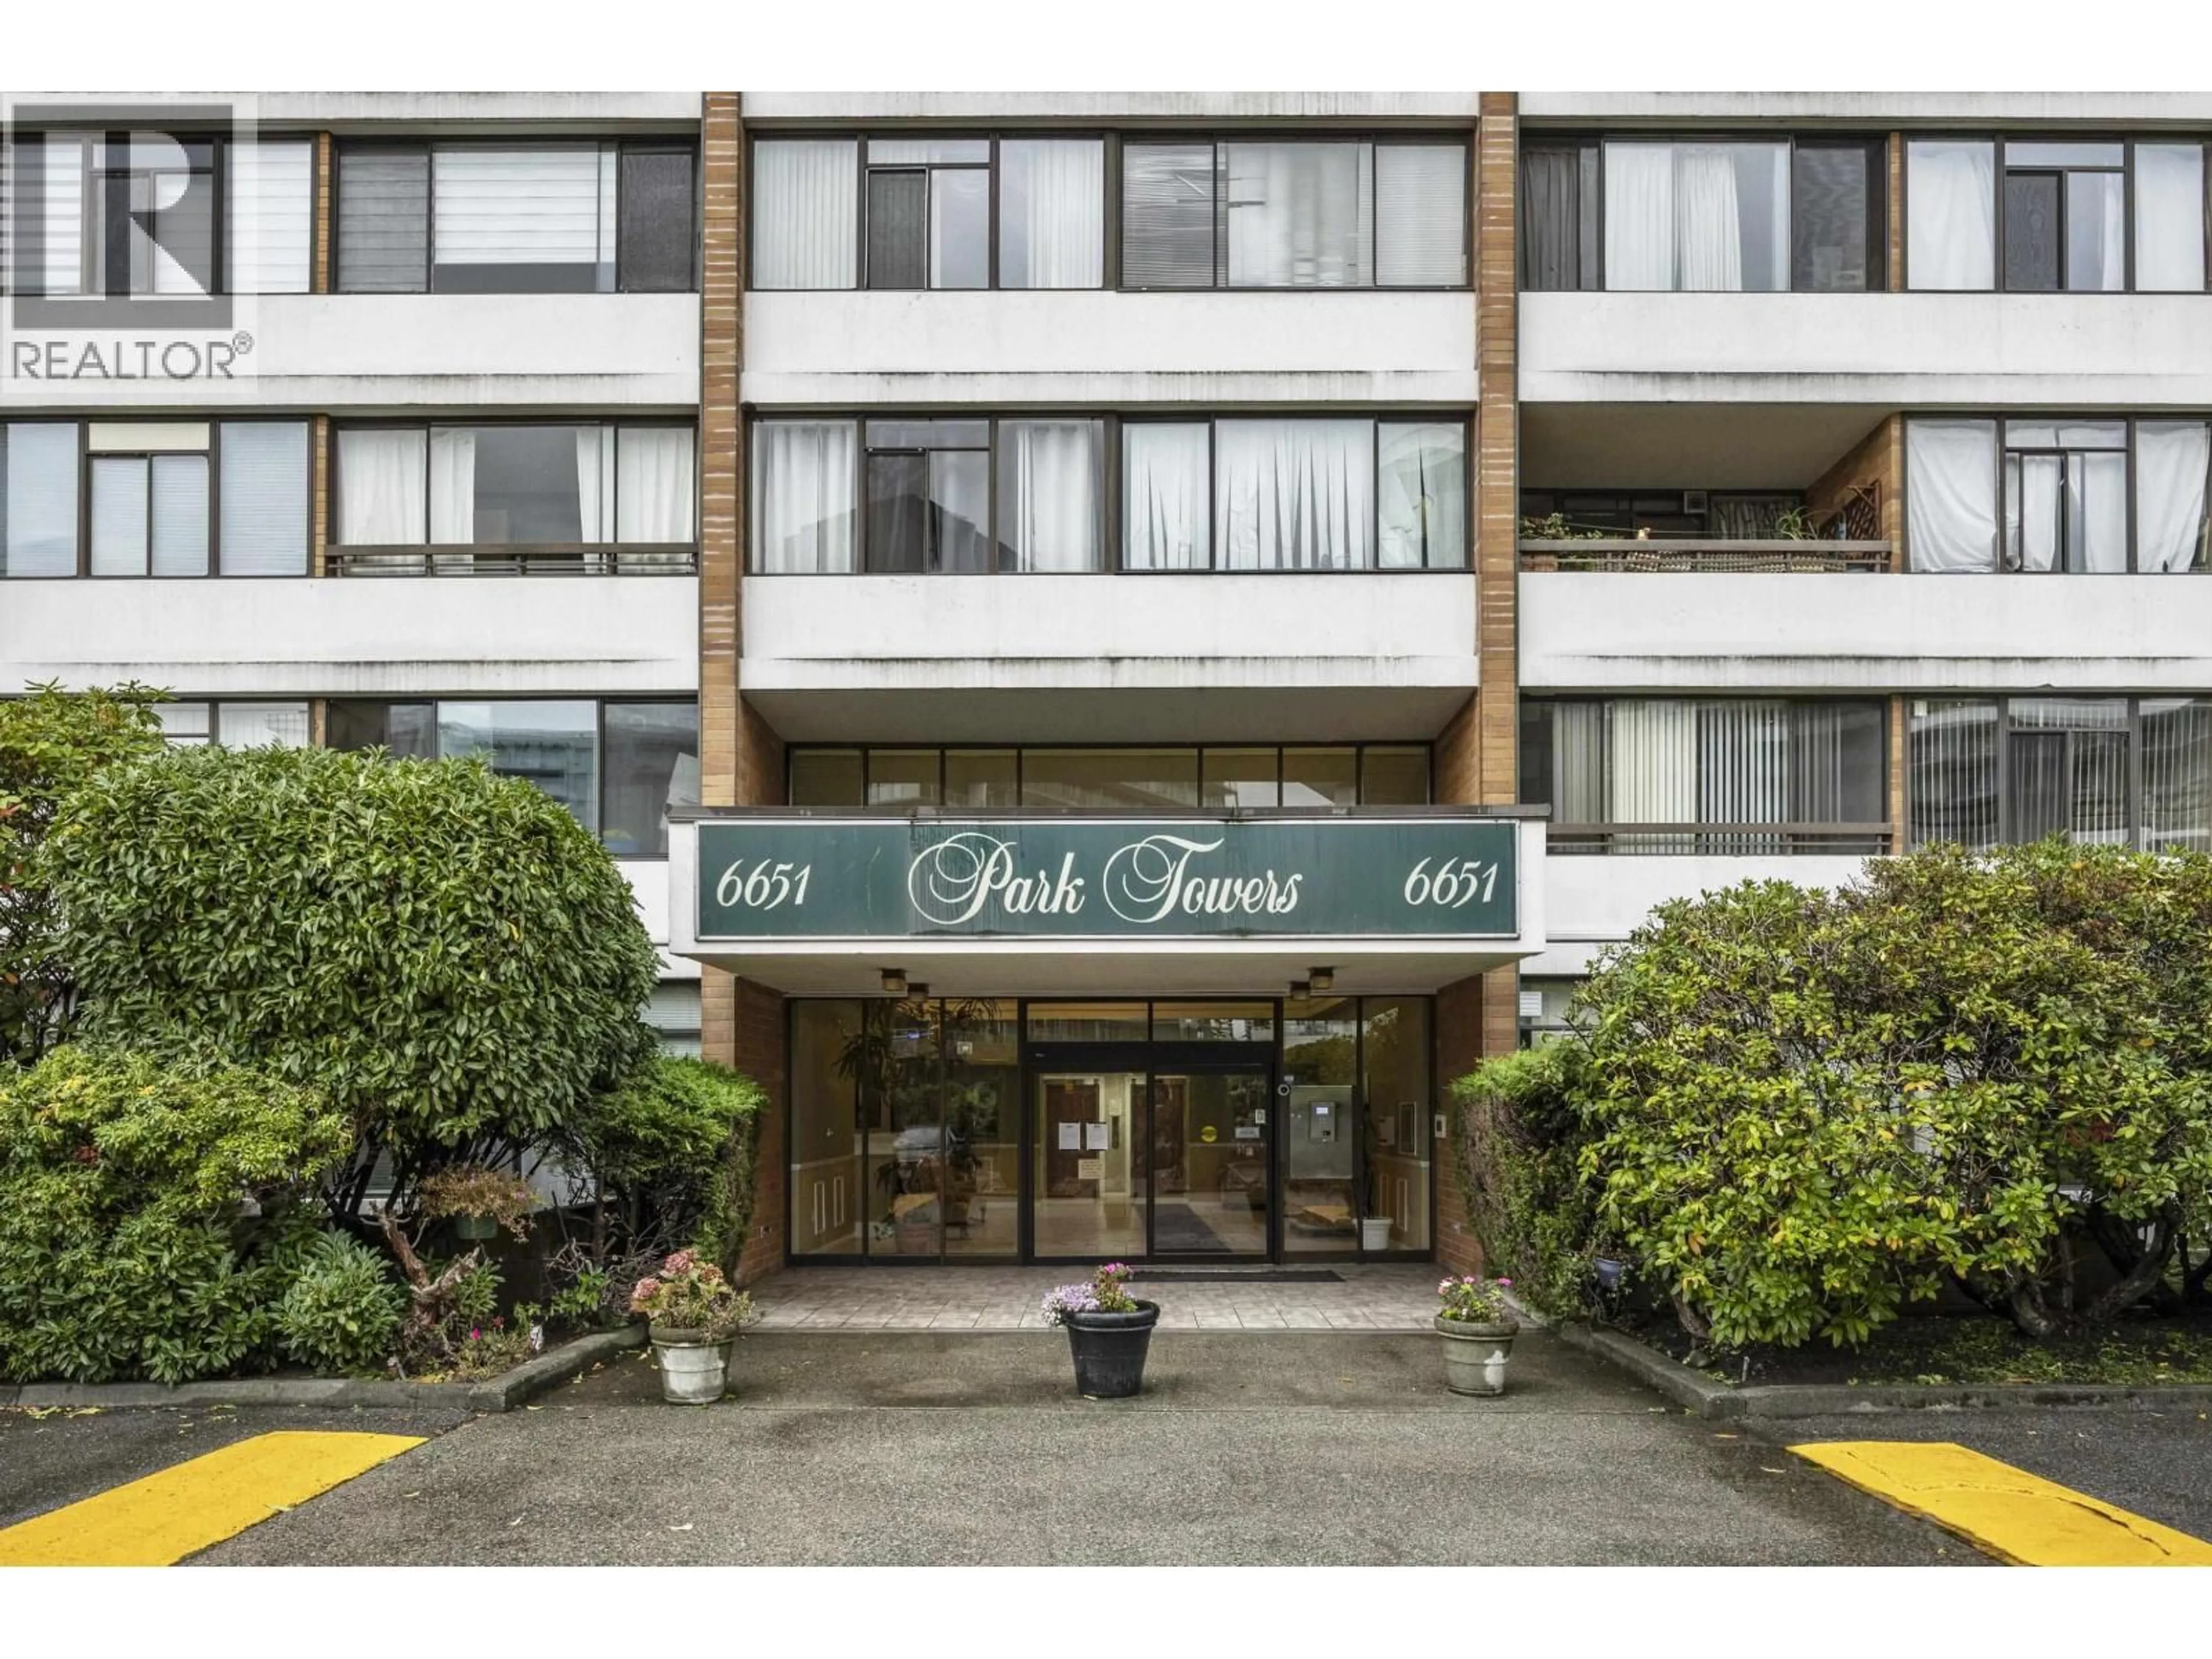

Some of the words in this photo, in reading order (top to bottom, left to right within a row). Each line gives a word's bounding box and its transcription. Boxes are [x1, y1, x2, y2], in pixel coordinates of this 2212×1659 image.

[717, 858, 811, 910] 6651
[908, 832, 1085, 925] Park
[1103, 835, 1303, 923] Towers
[1404, 857, 1498, 908] 6651
